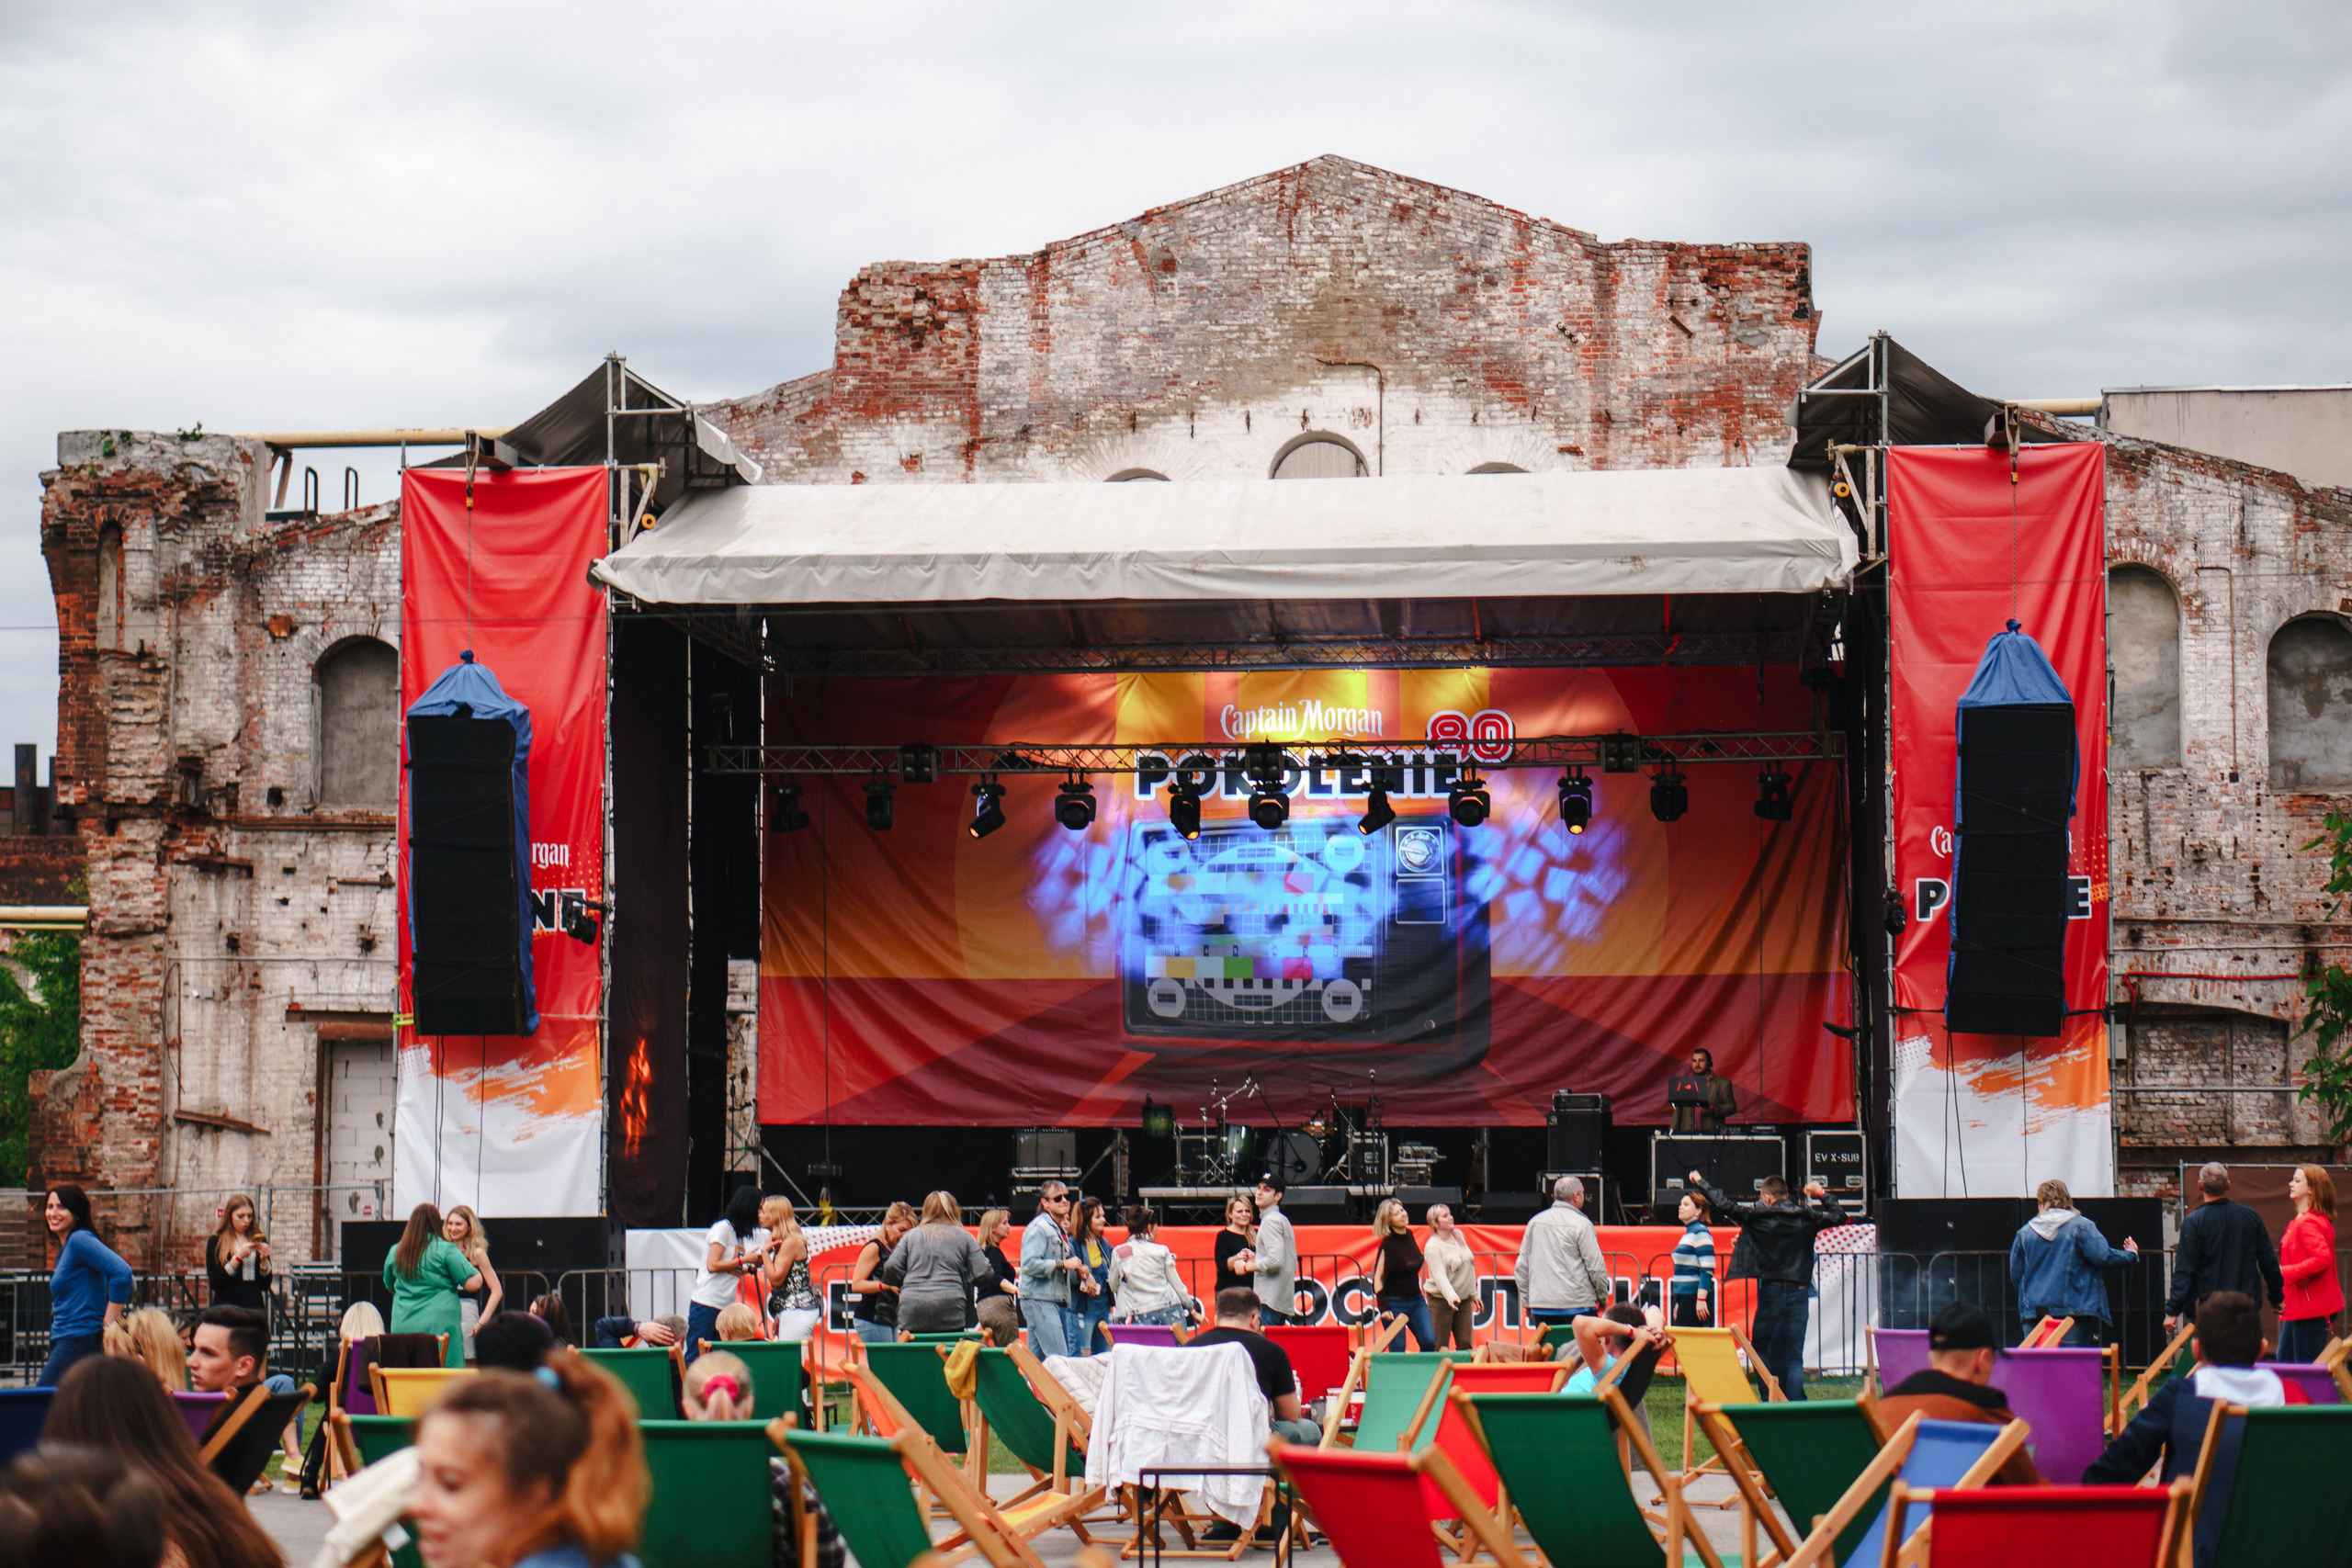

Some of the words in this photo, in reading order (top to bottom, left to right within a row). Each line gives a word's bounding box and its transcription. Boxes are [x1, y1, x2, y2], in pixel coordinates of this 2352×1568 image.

[1220, 700, 1297, 740] Captain
[1295, 699, 1383, 739] Morgan
[1426, 708, 1514, 764] 80
[532, 841, 570, 870] rgan
[1815, 1152, 1828, 1163] EV
[1830, 1152, 1860, 1163] X-SUB
